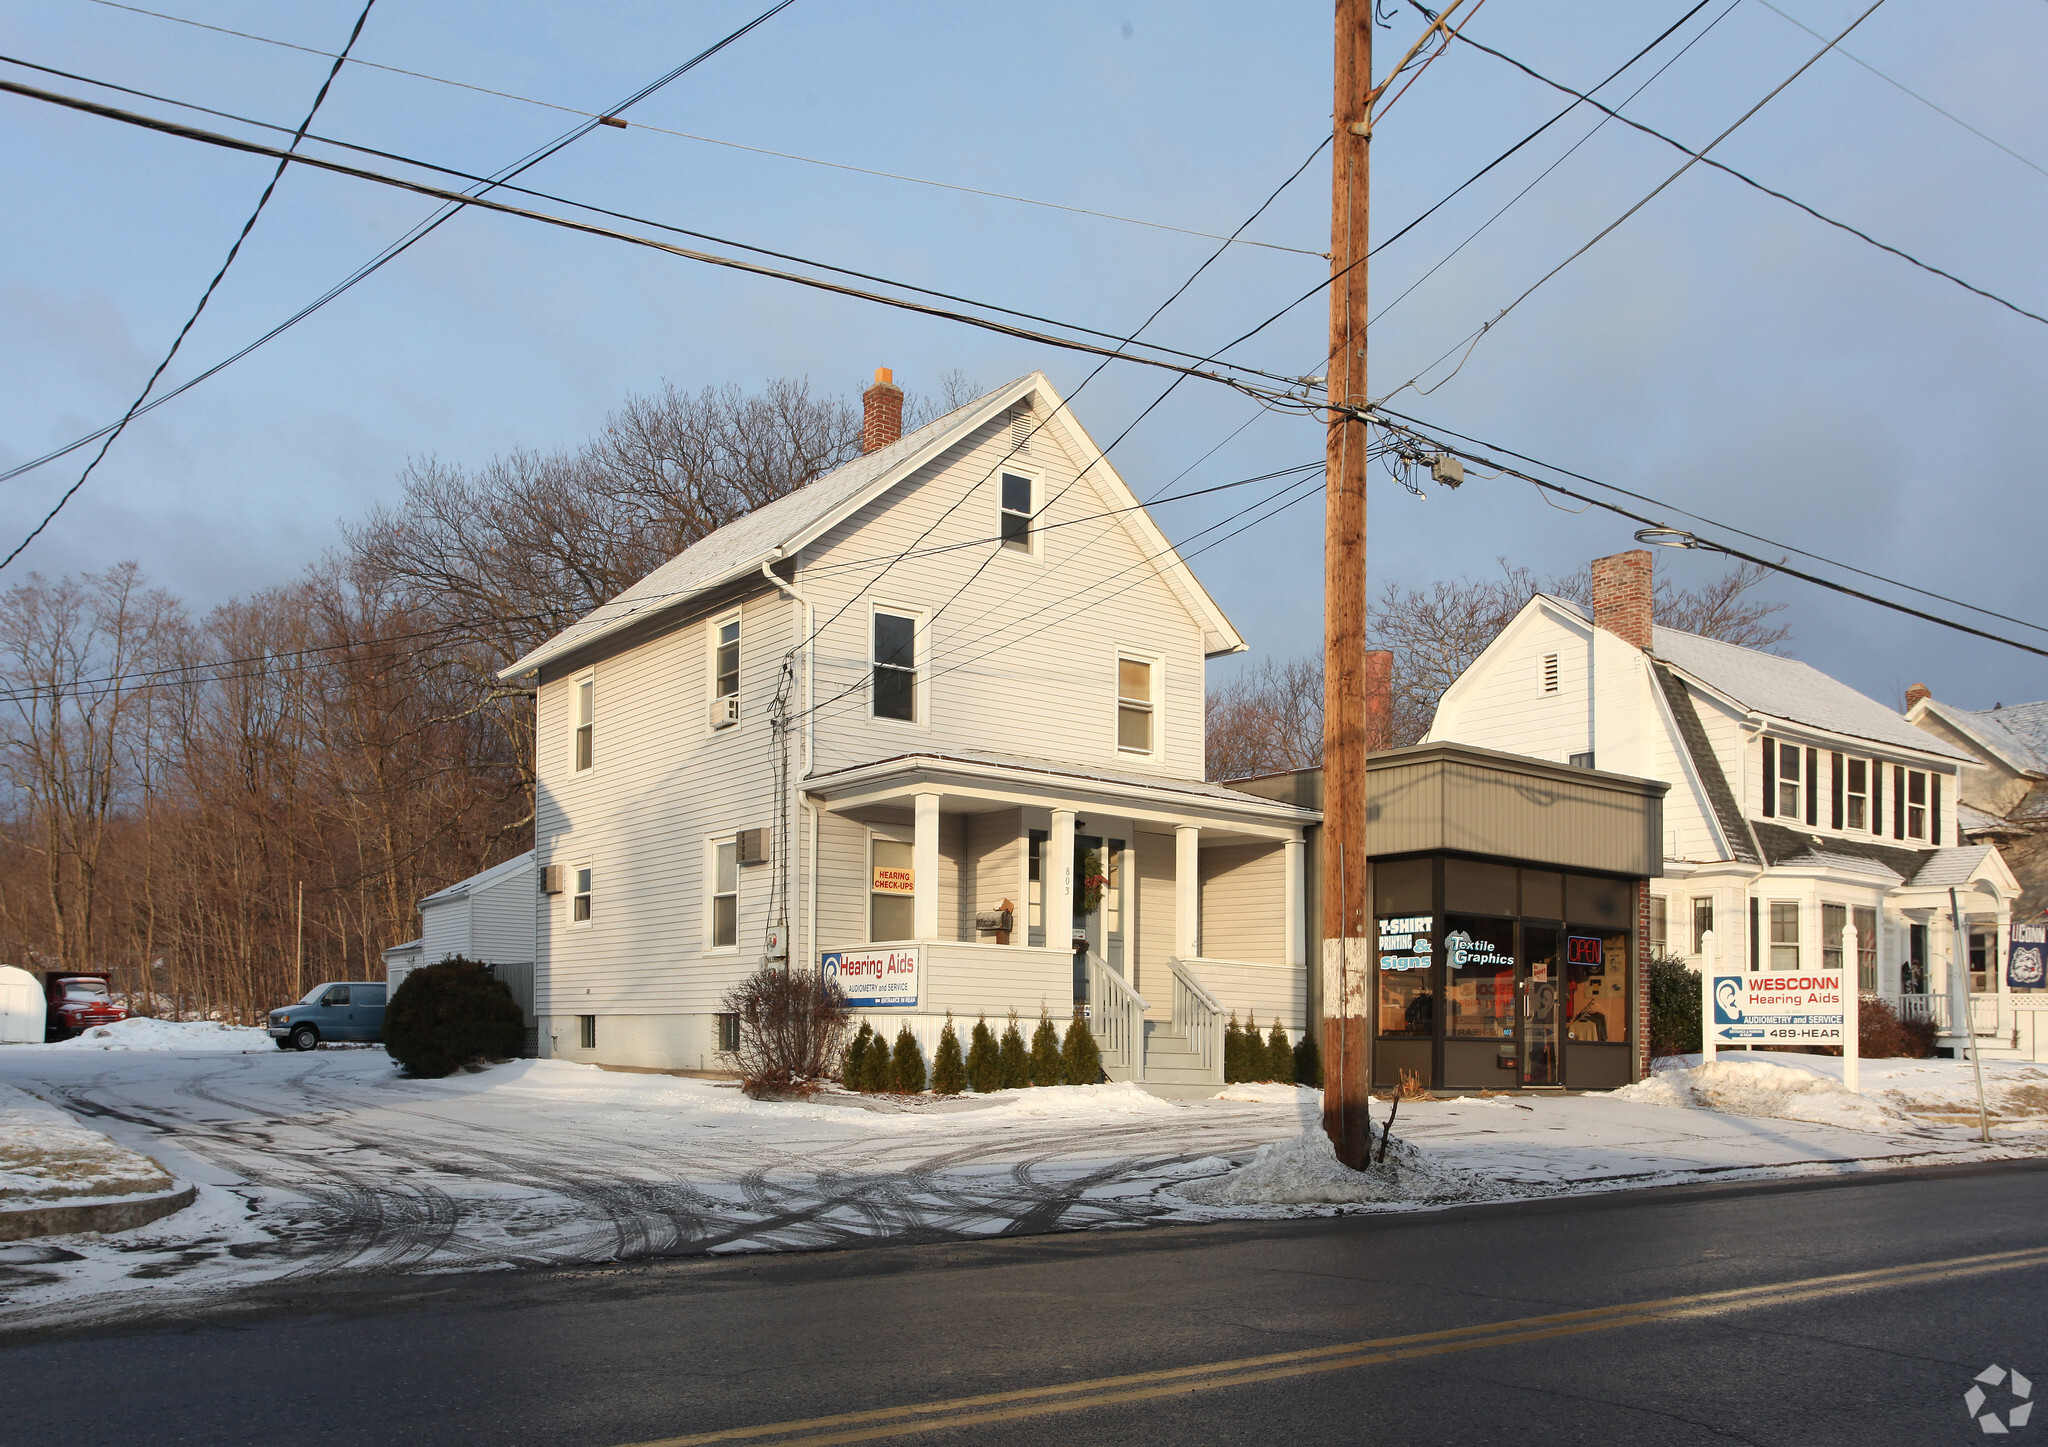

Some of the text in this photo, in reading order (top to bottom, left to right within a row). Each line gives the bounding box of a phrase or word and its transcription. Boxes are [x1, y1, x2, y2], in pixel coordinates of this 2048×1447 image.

[879, 871, 910, 881] HEARING
[874, 880, 914, 891] CHECK-UPS
[1379, 916, 1433, 935] T-SHIRT
[2012, 924, 2046, 944] UCONN
[1379, 934, 1433, 954] PRINTING &
[1451, 936, 1495, 952] Textile
[1569, 938, 1600, 963] OPEN
[1380, 955, 1432, 971] Signs
[1454, 949, 1514, 966] Graphics
[840, 953, 914, 979] Hearing Aids
[849, 983, 908, 993] AUDIOMETRY and SERVICE
[1749, 977, 1839, 991] WESCONN
[1749, 992, 1840, 1006] Hearing Aids
[1743, 1015, 1842, 1024] AUDIOMETRY and SERVICE
[1770, 1029, 1840, 1038] 489-HEAR
